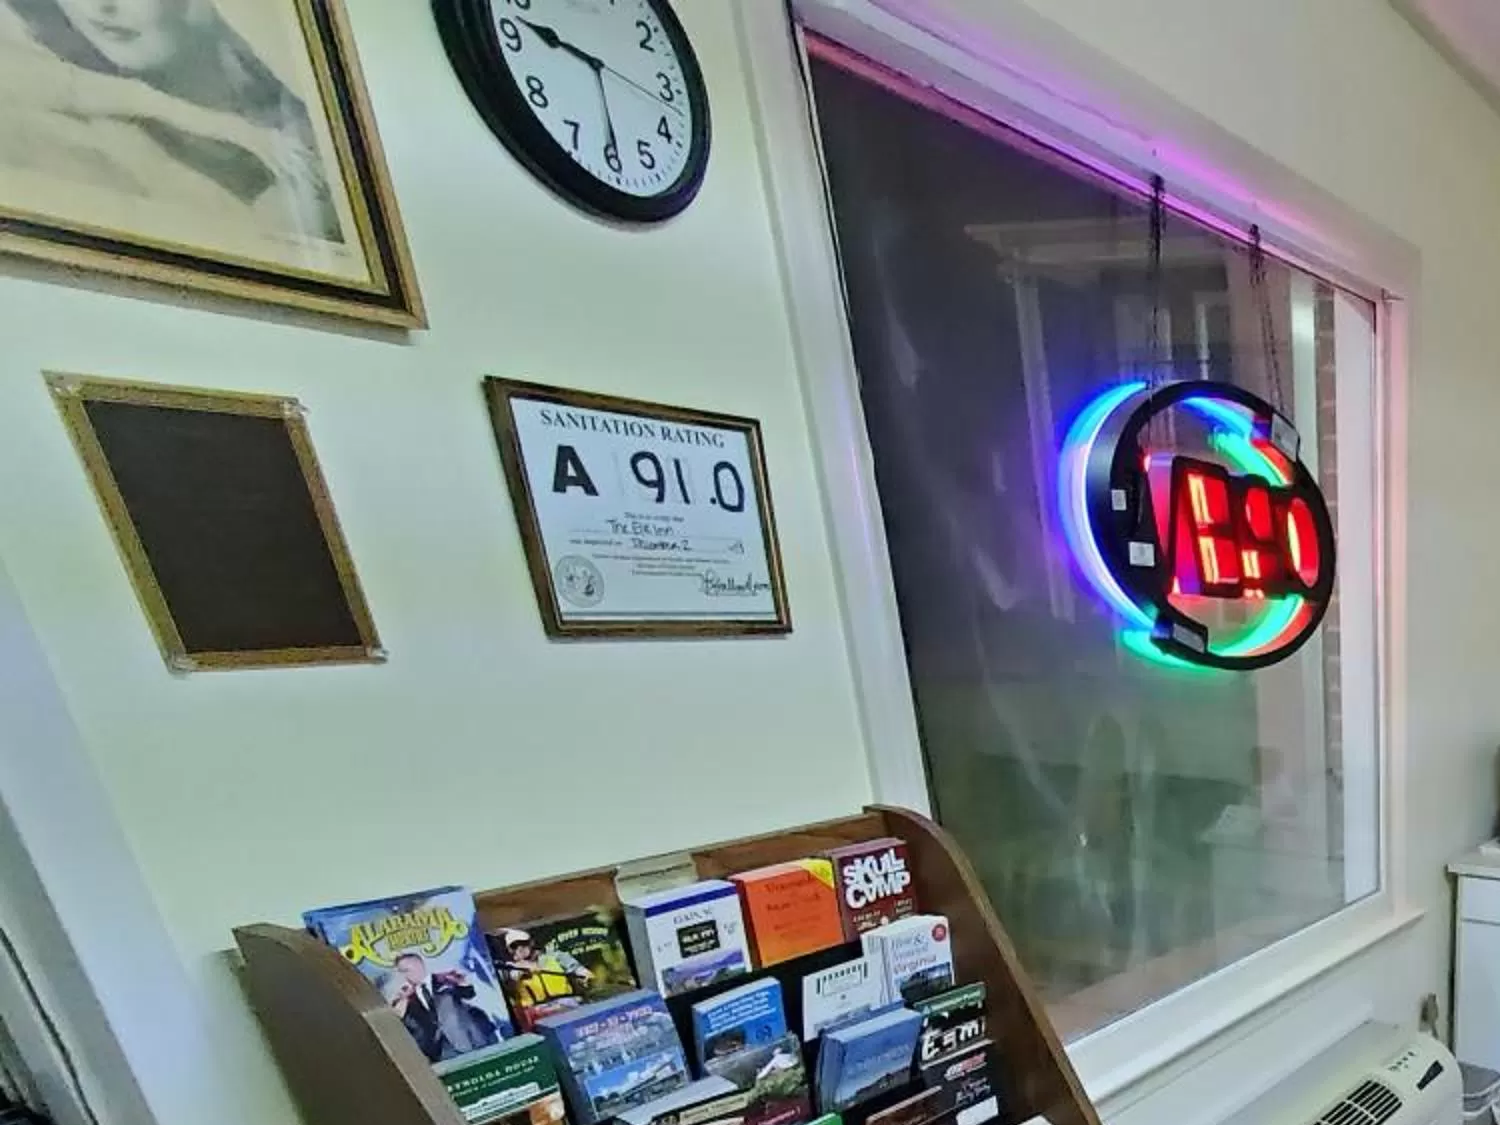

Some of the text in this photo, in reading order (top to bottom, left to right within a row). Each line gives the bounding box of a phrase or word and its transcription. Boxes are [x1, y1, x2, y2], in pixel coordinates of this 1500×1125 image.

[500, 18, 522, 52] 9
[635, 20, 655, 52] 2
[525, 75, 549, 109] 8
[656, 72, 675, 102] 3
[563, 119, 580, 150] 7
[656, 115, 672, 144] 4
[603, 143, 622, 173] 6
[636, 139, 655, 170] 5
[540, 409, 725, 448] SANITATION RATING
[551, 444, 600, 497] A
